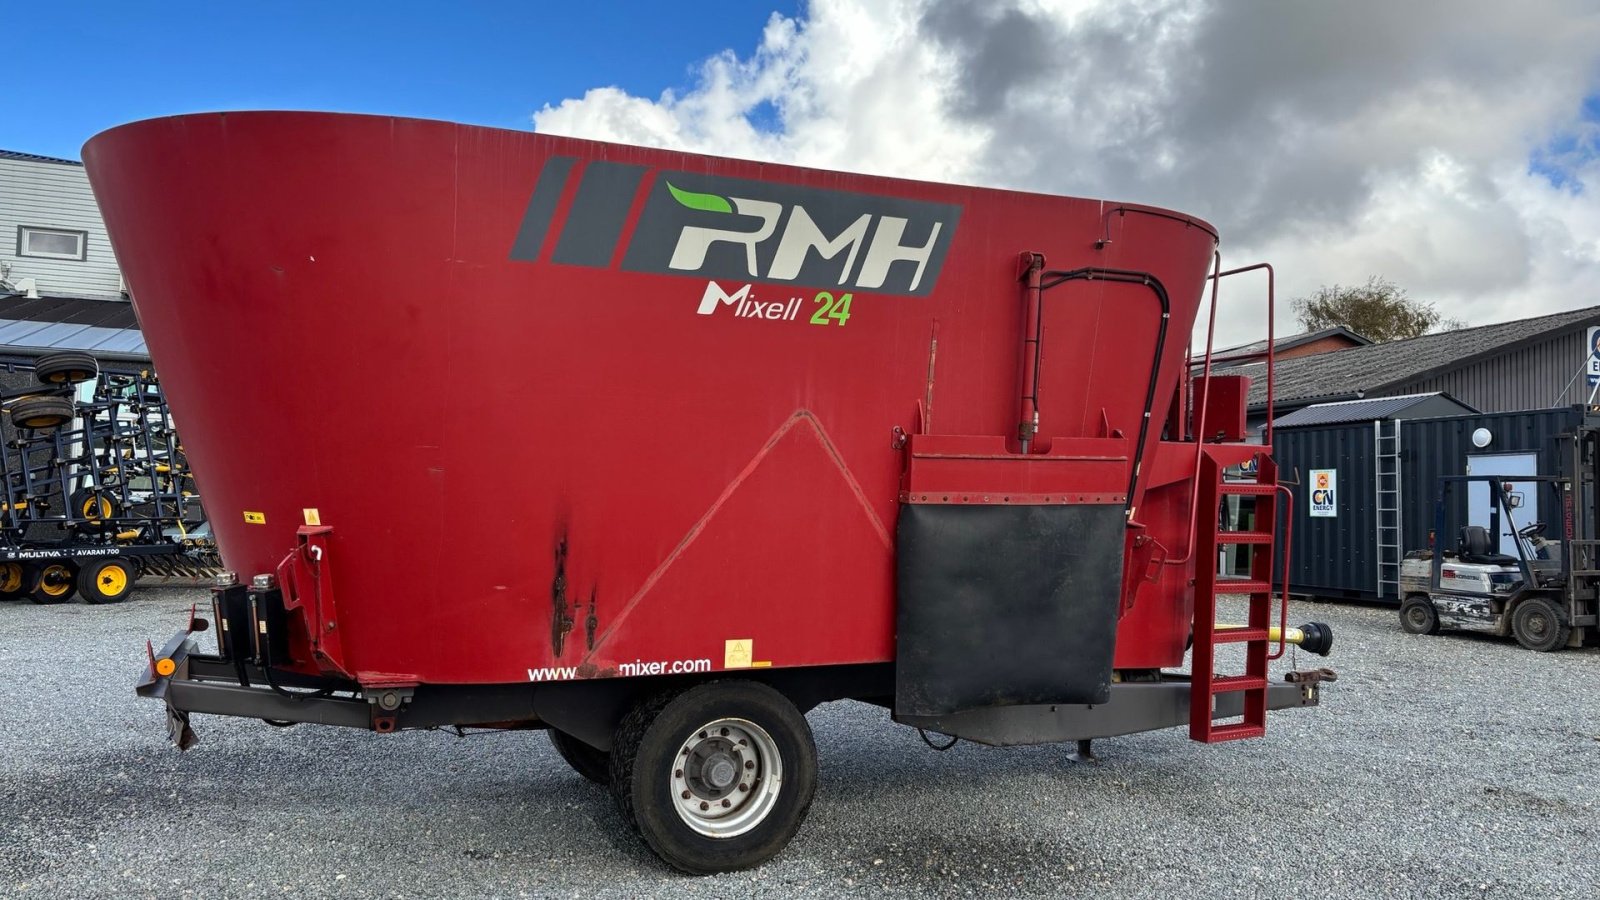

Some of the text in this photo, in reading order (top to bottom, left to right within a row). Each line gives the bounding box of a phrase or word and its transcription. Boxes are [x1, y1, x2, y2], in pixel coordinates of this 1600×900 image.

[667, 196, 943, 292] RMH
[697, 281, 853, 326] Mixell 24
[1312, 489, 1334, 505] CN
[19, 550, 61, 559] MULTIVA
